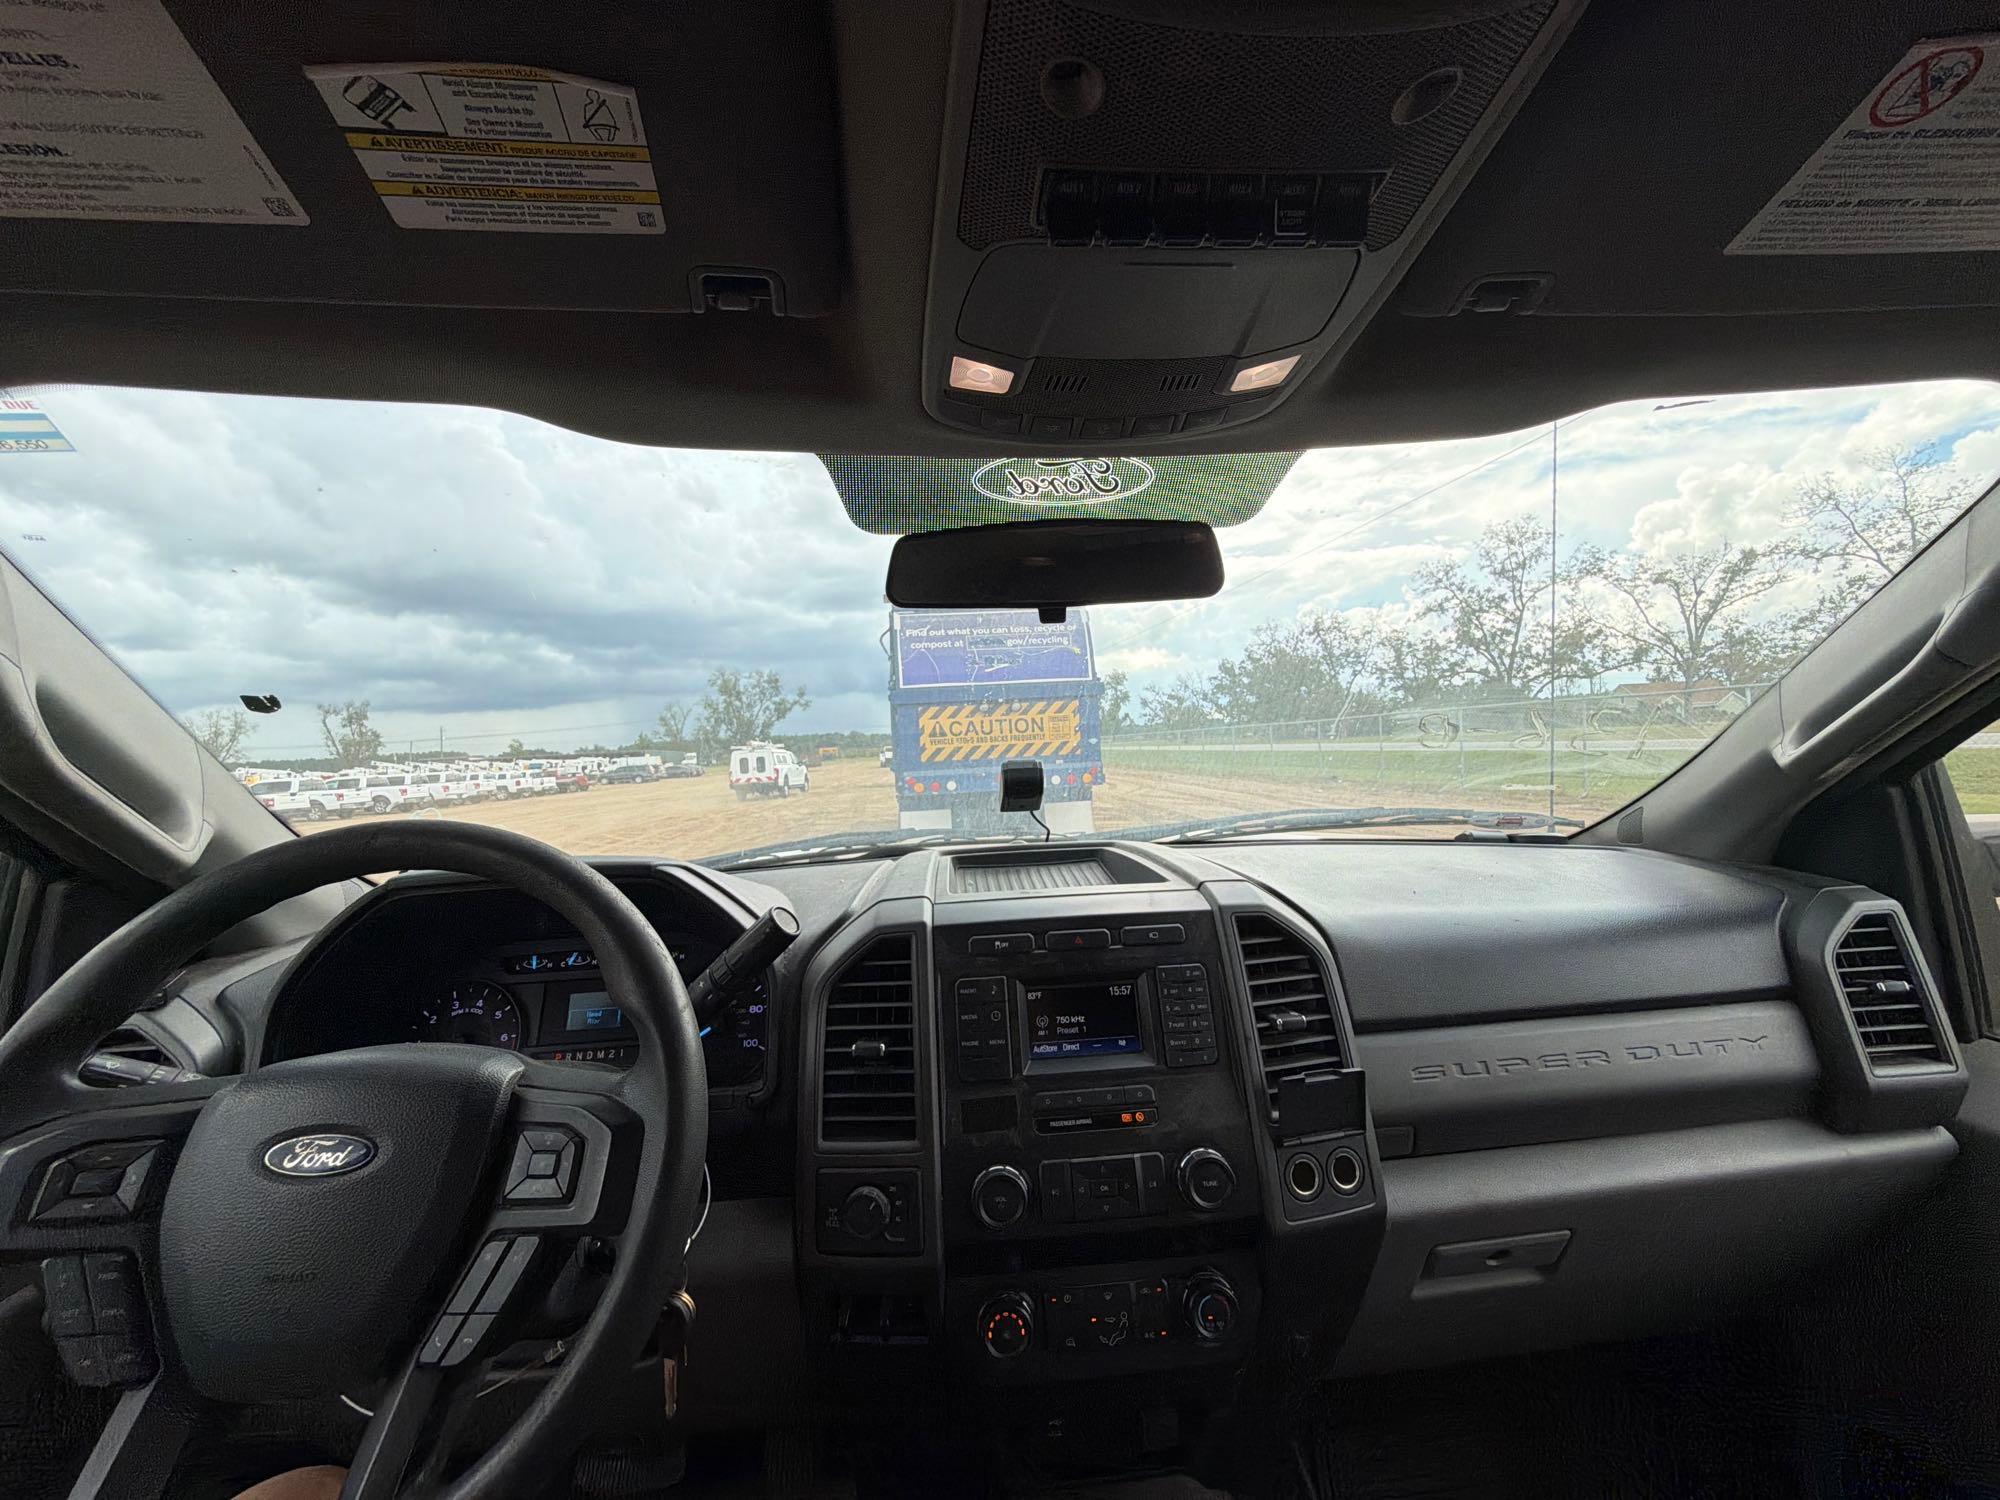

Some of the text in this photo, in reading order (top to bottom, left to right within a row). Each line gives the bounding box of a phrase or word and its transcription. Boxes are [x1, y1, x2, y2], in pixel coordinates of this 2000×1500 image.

[385, 137, 509, 153] AVERTISSEMENT:
[906, 627, 928, 637] Find
[948, 628, 972, 636] what
[972, 628, 990, 638] you
[1010, 626, 1032, 635] toss,
[1034, 624, 1066, 635] recycle
[911, 641, 952, 650] compost
[954, 640, 964, 648] at
[949, 717, 1045, 737] CAUTION
[930, 737, 954, 745] VEHICLE
[976, 736, 989, 744] AND
[990, 735, 1009, 743] BACKS
[1010, 733, 1046, 742] FREQUENTLY
[1109, 985, 1132, 996] 15:57
[452, 1001, 460, 1009] 3
[476, 999, 484, 1007] 4
[749, 1005, 763, 1014] 80
[429, 1015, 438, 1024] 2
[494, 1011, 502, 1019] 5
[1071, 1014, 1086, 1024] kHz
[1057, 1026, 1079, 1035] Preset
[500, 1033, 508, 1042] 6
[743, 1039, 758, 1048] 100
[1062, 1042, 1080, 1052] Direct
[1412, 1035, 1768, 1083] SUPER DUTY
[283, 1139, 354, 1169] Ford
